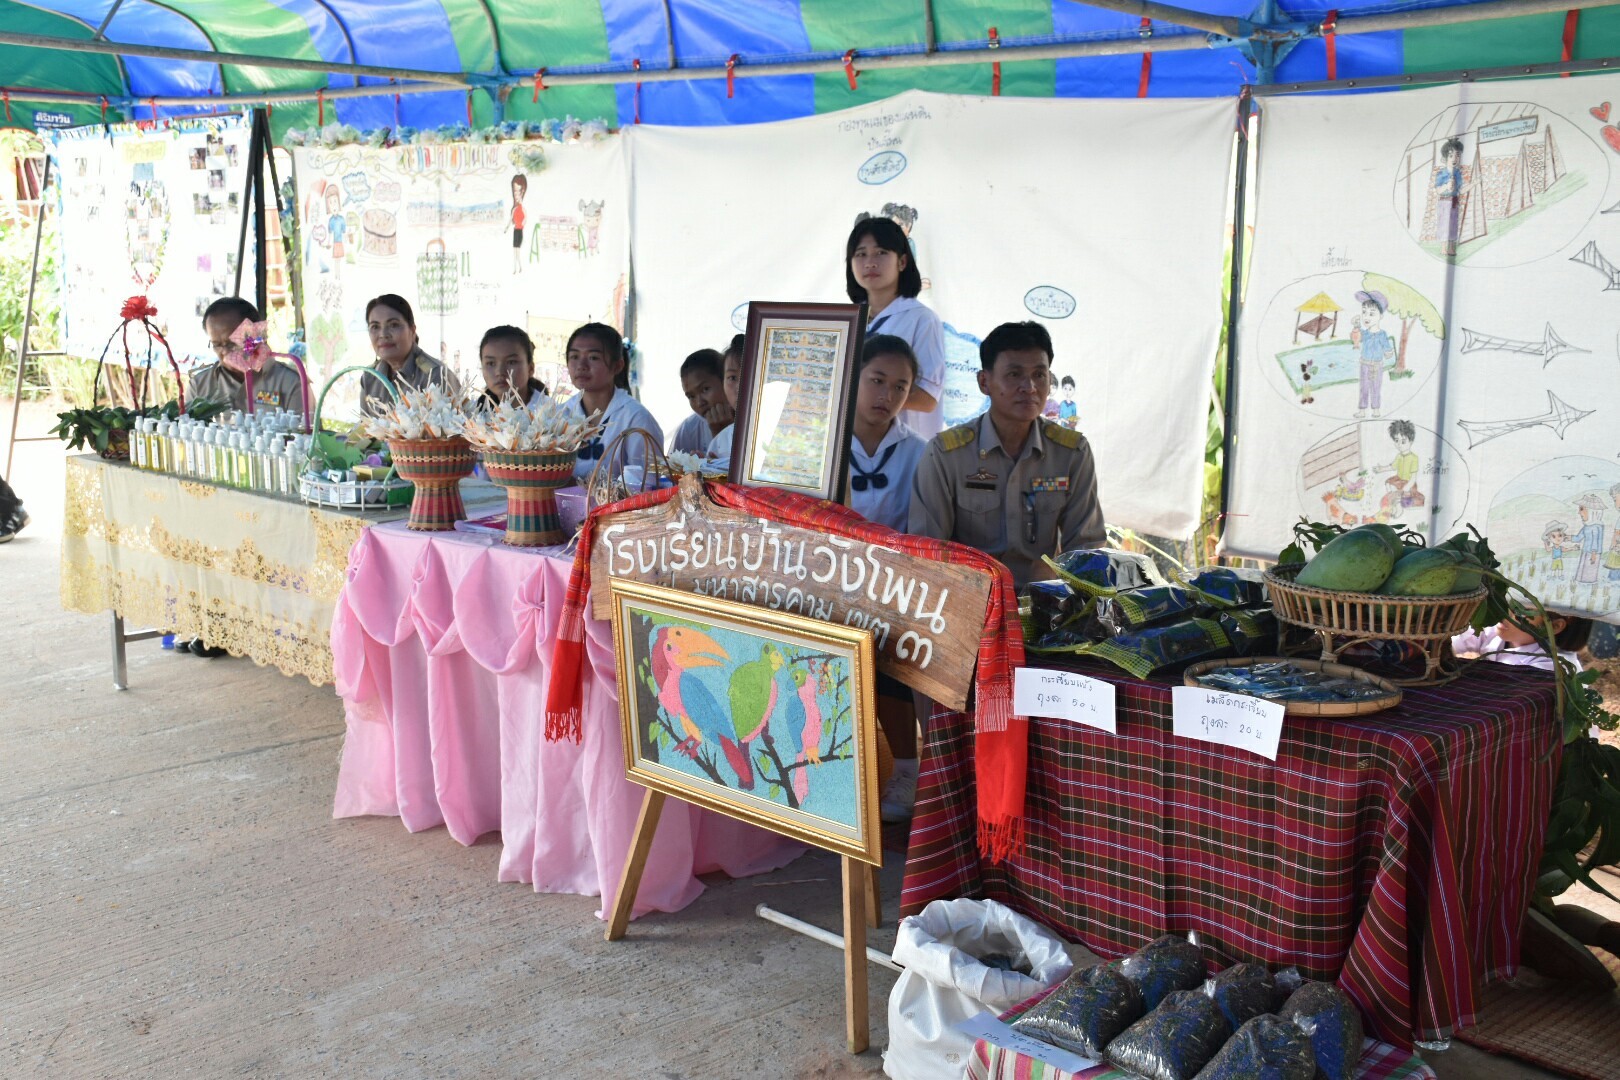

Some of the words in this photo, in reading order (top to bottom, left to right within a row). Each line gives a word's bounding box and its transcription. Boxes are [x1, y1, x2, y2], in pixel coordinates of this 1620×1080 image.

[602, 513, 949, 634] โรงเรียนบ้านวังโพน
[693, 575, 834, 622] มหาสารคาม
[895, 629, 934, 671] ๓
[1200, 715, 1229, 735] ถุงละ
[1239, 723, 1252, 734] 20
